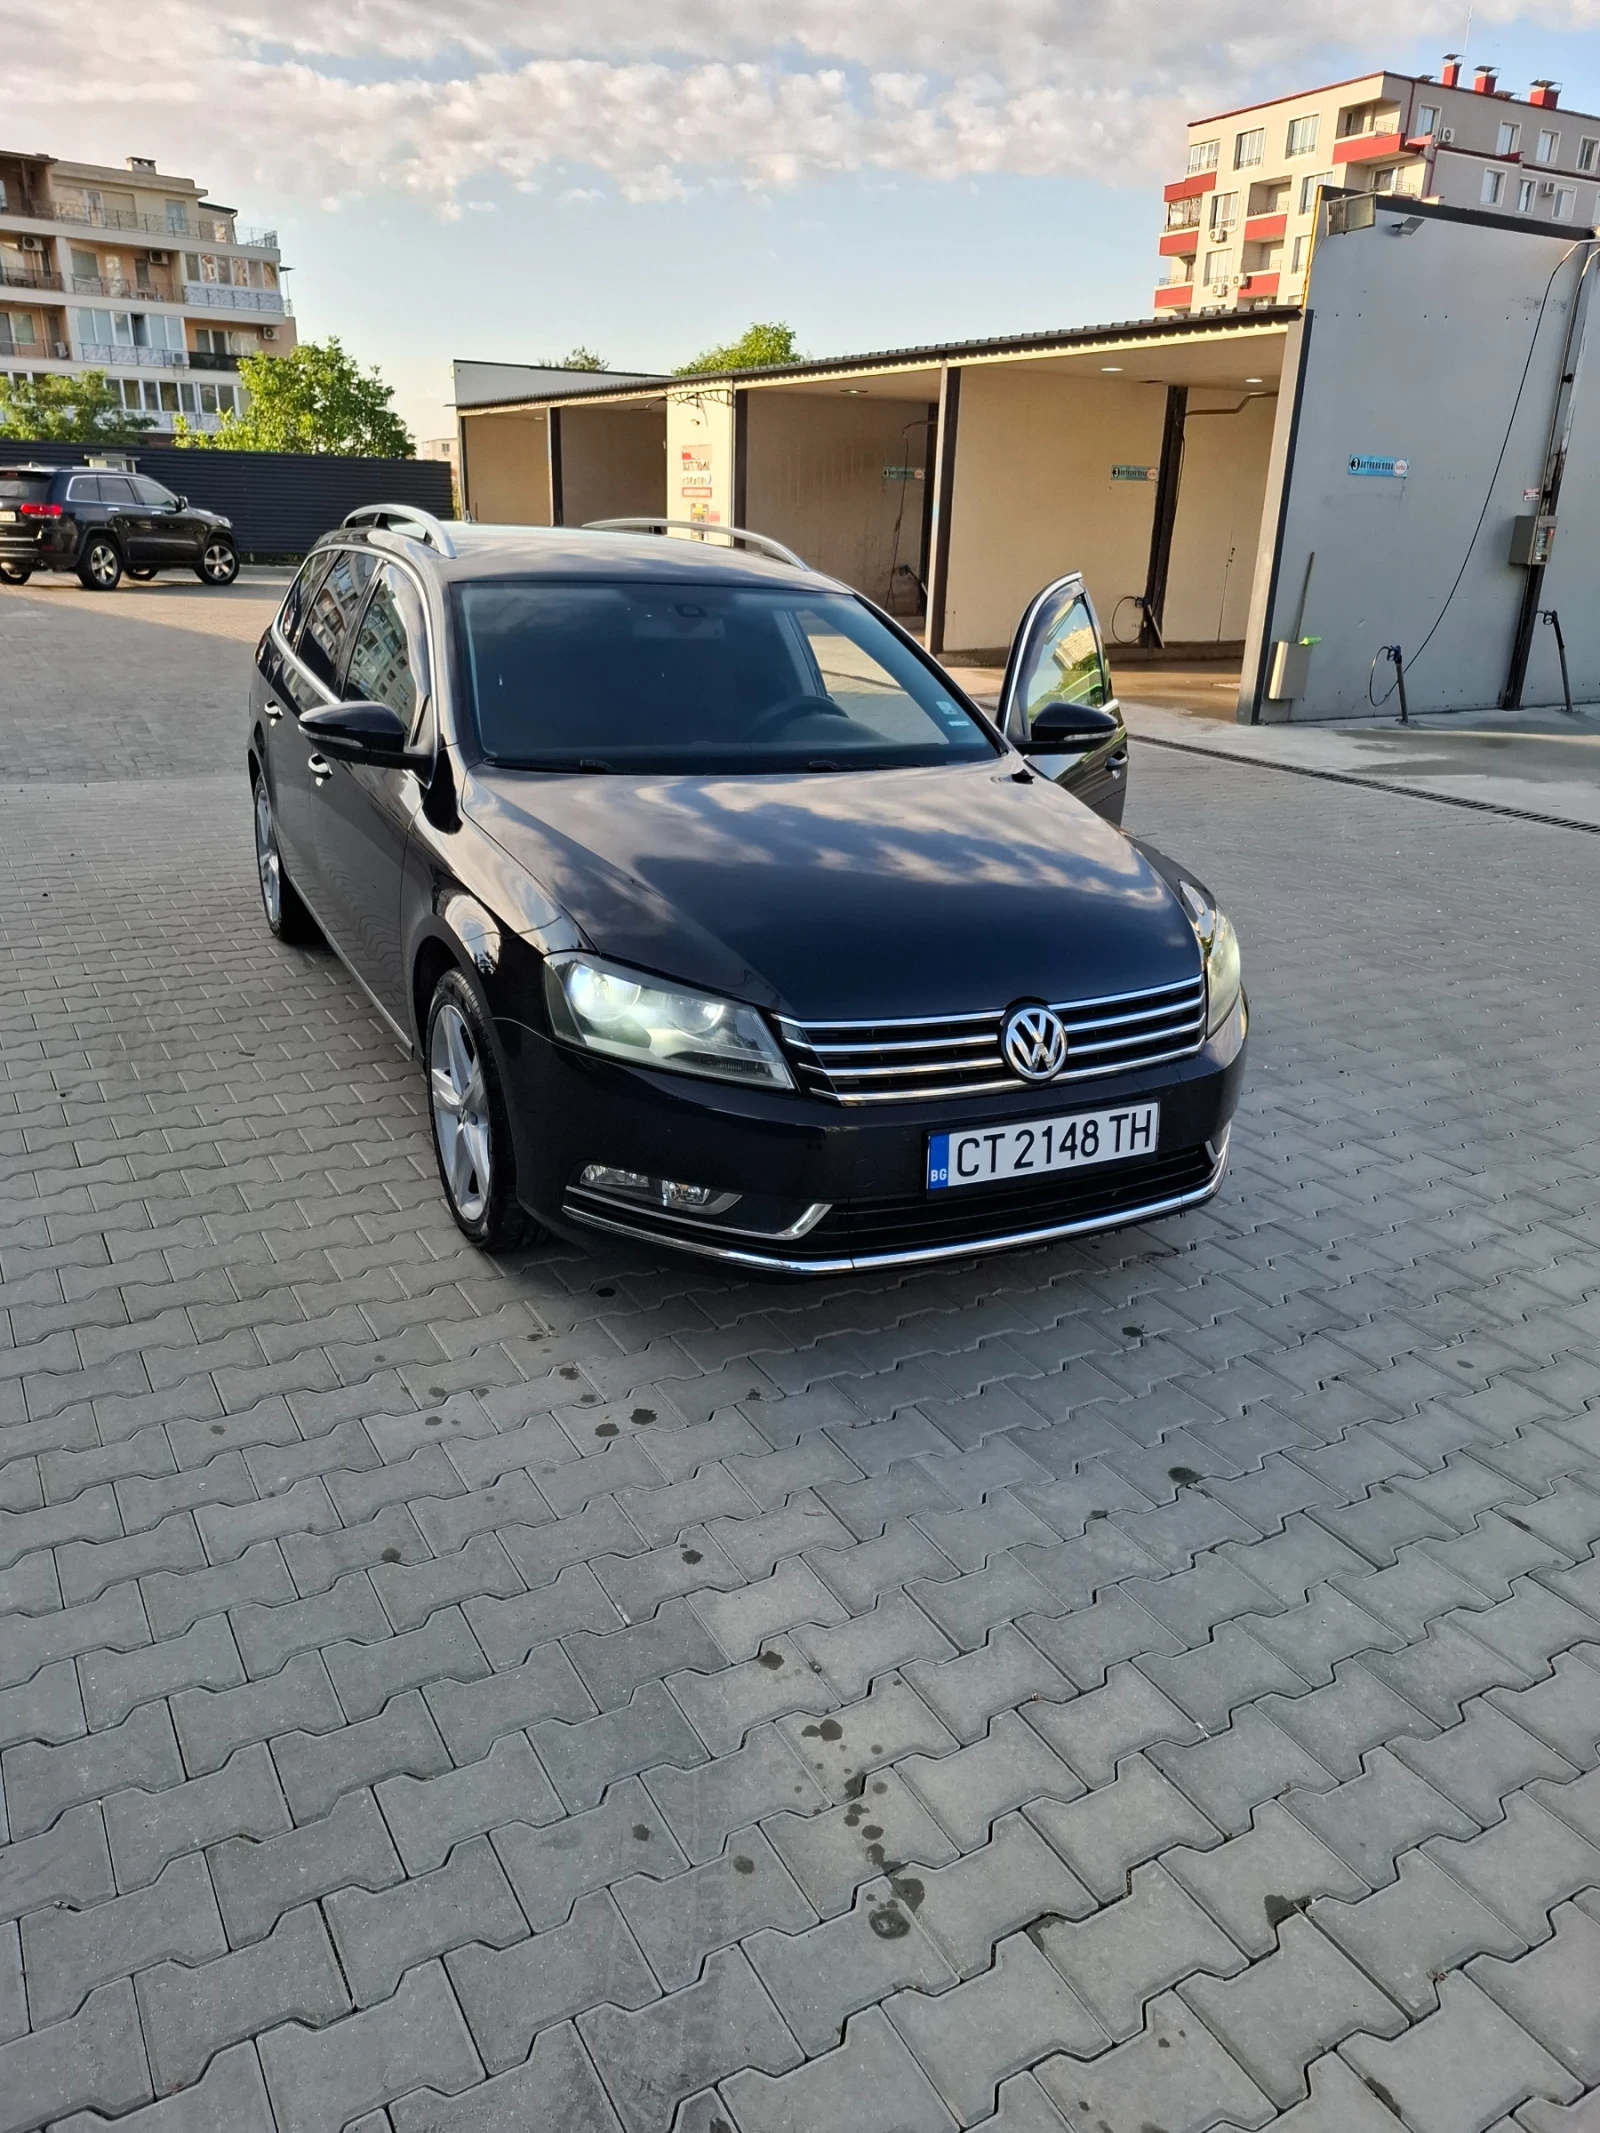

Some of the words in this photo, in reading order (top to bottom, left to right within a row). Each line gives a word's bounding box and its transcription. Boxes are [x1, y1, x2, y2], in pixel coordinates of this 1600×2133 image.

[1006, 1008, 1066, 1080] VW
[931, 1167, 948, 1183] BG
[957, 1133, 1005, 1177] CT
[1014, 1119, 1100, 1170] 2148
[1109, 1109, 1152, 1153] TH
